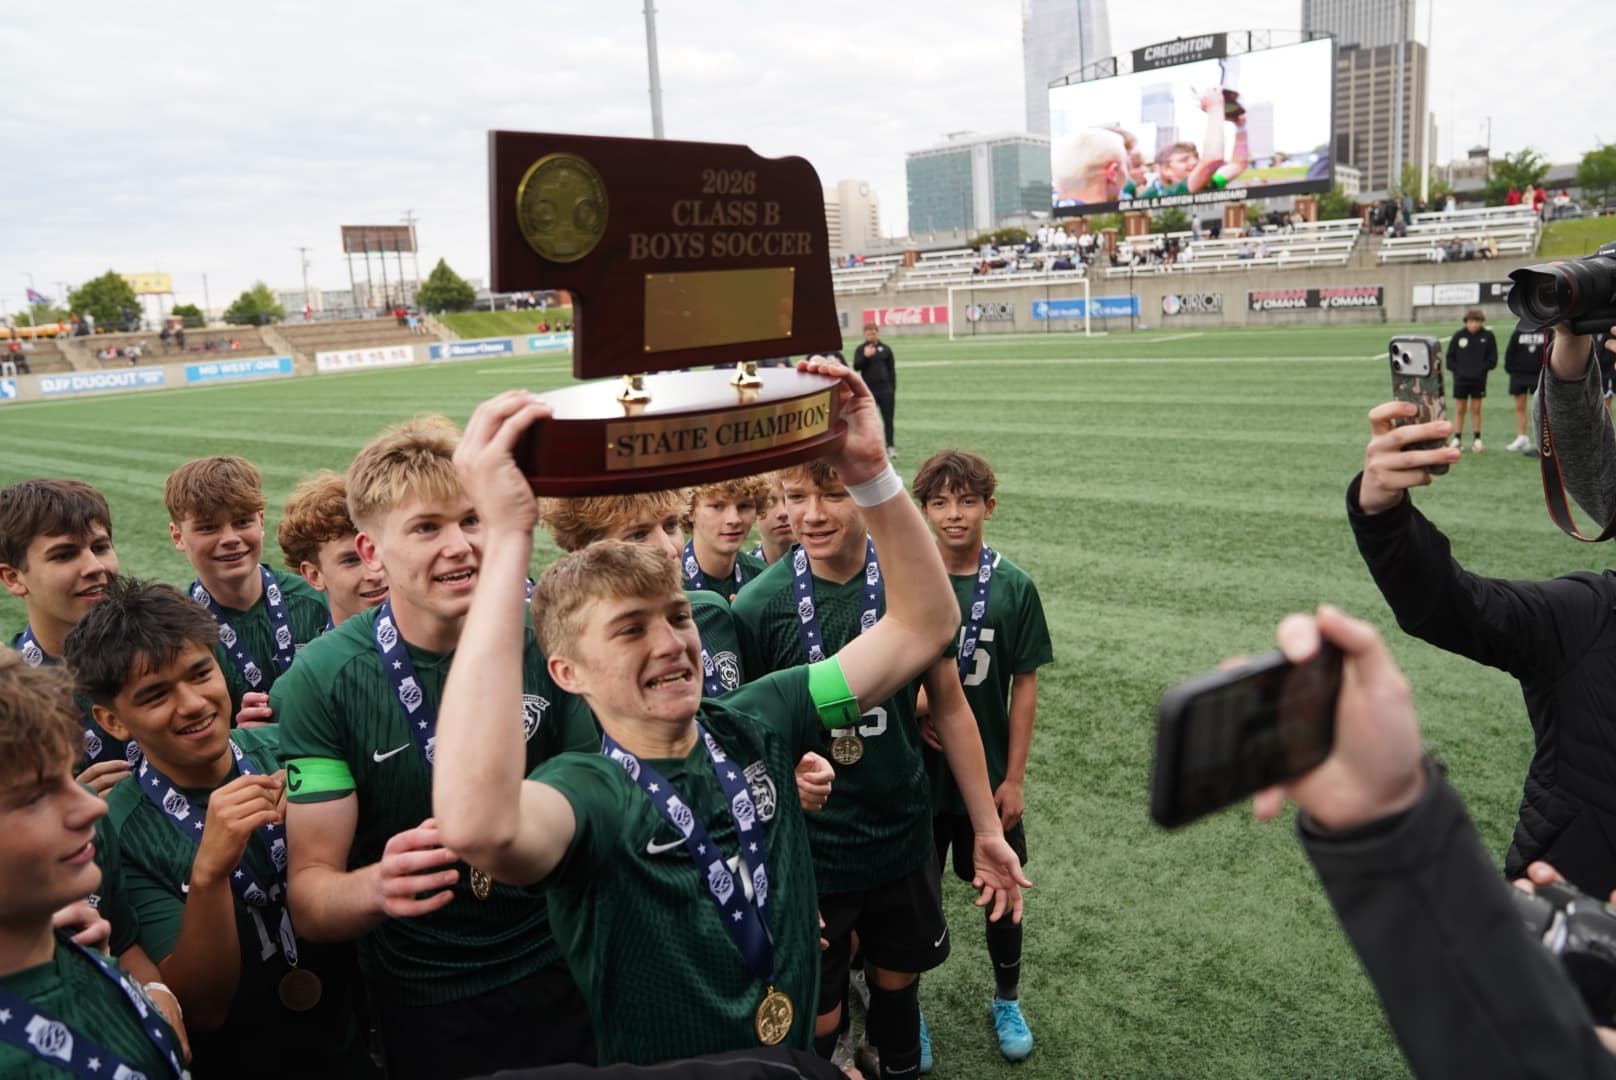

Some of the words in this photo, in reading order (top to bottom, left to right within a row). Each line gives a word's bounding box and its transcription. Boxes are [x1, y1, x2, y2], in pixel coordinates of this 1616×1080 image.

[1144, 36, 1214, 61] CREIGHTON
[702, 169, 757, 195] 2026
[671, 201, 757, 226] CLASS
[764, 201, 780, 226] B
[629, 233, 705, 260] BOYS
[711, 231, 812, 258] SOCCER
[1263, 298, 1307, 309] OMAHA
[1331, 295, 1378, 307] OMAHA
[72, 372, 137, 390] DUGOUT
[616, 427, 708, 458] STATE
[716, 403, 826, 446] CHAMPION
[287, 764, 303, 792] C
